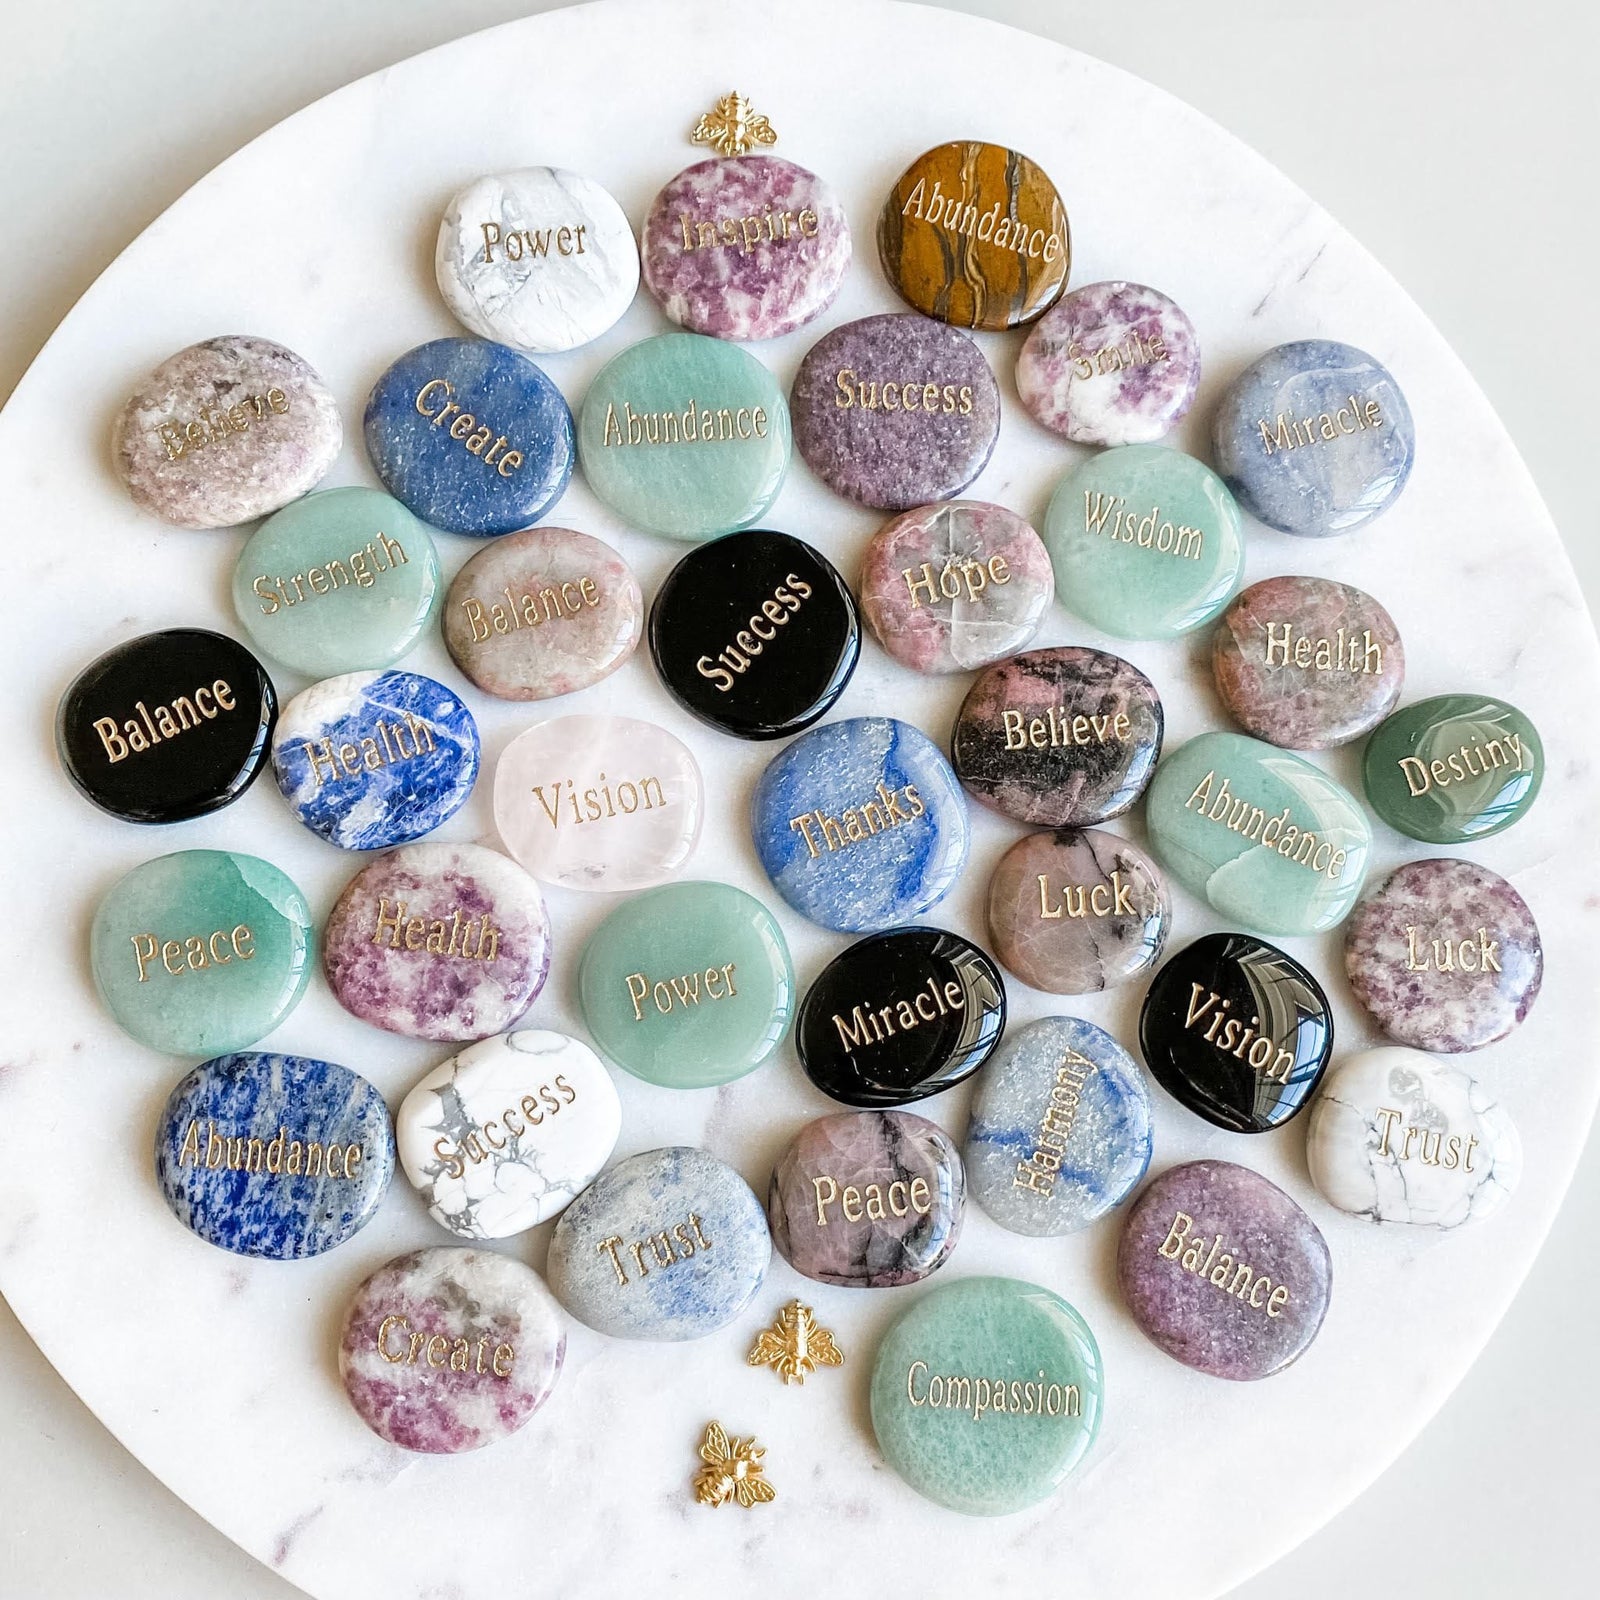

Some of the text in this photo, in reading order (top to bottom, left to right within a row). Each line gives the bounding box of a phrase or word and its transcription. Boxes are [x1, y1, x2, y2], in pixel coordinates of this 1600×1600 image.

[484, 222, 586, 263] Power
[679, 206, 820, 253] Inspire
[902, 180, 1061, 264] Abundance
[1068, 329, 1168, 380] Smile
[161, 386, 290, 461] Believe
[602, 400, 768, 446] Abundance
[834, 370, 973, 413] Success
[415, 379, 524, 477] Create
[1257, 395, 1383, 456] Miracle
[1083, 491, 1203, 560] Wisdom
[251, 532, 409, 616] Strength
[903, 554, 1011, 608] Hope
[462, 576, 599, 641] Balance
[697, 573, 813, 692] Success
[1262, 622, 1383, 674] Health
[93, 678, 237, 763] Balance
[303, 712, 437, 787] Health
[1002, 705, 1133, 751] Believe
[1399, 731, 1522, 797] Destiny
[531, 772, 665, 829] Vision
[789, 782, 924, 860] Thanks
[1185, 771, 1347, 880] Abundance
[1038, 874, 1136, 920] Luck
[134, 923, 255, 983] Peace
[373, 899, 502, 962] Health
[1405, 927, 1503, 973] Luck
[627, 963, 737, 1020] Power
[833, 978, 965, 1054] Miracle
[1183, 982, 1296, 1084] Vision
[176, 1120, 364, 1182] Abundance
[434, 1073, 576, 1180] Success
[1012, 1047, 1098, 1196] Harmony
[1375, 1108, 1478, 1174] Trust
[813, 1176, 932, 1227] Peace
[597, 1213, 711, 1285] Trust
[1158, 1212, 1288, 1319] Balance
[377, 1315, 514, 1380] Create
[906, 1361, 1082, 1420] Compassion
